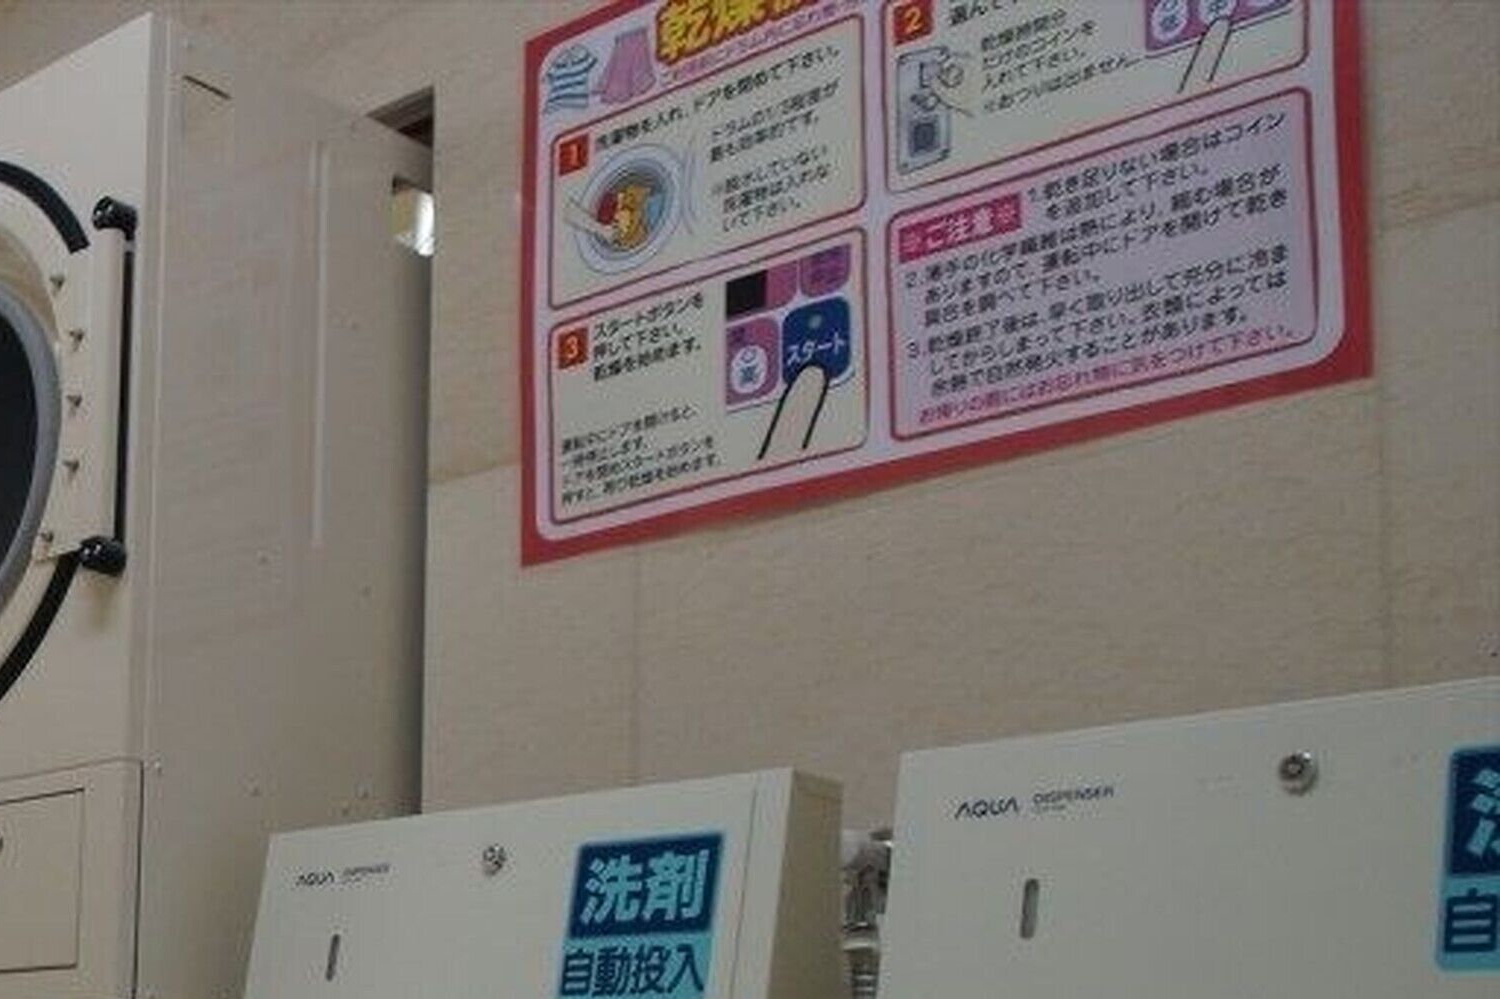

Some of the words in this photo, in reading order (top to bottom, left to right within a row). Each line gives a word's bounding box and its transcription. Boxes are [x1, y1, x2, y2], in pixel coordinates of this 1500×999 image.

[904, 8, 922, 30] 2
[593, 291, 705, 340] スタートボタンを
[786, 330, 846, 367] スタート
[953, 797, 1019, 820] AQUA
[580, 849, 711, 924] 洗剤
[560, 943, 705, 998] 自動投入
